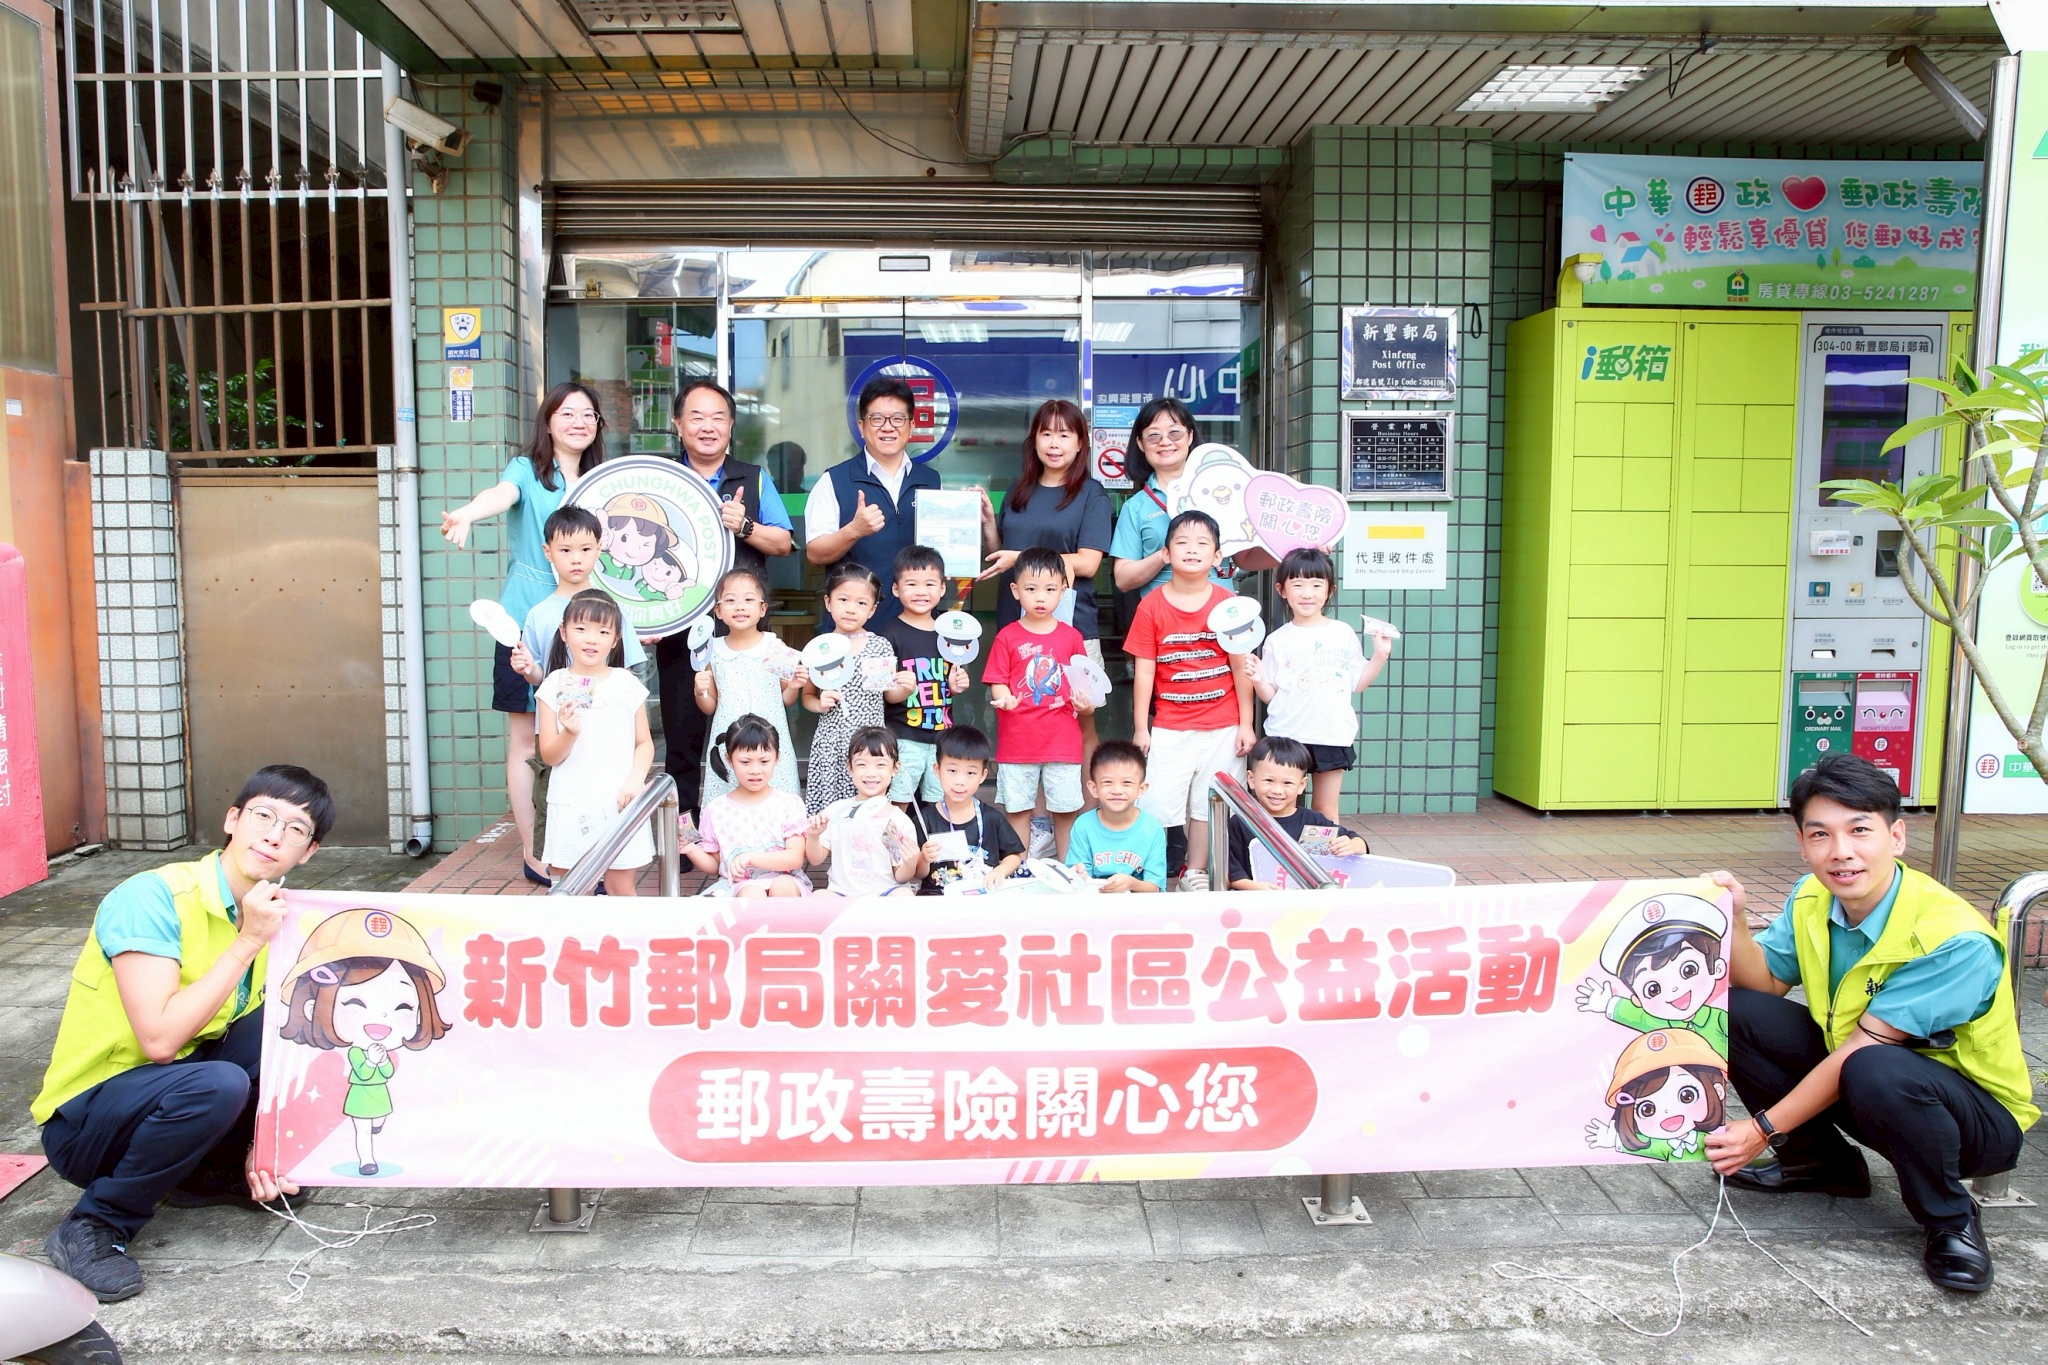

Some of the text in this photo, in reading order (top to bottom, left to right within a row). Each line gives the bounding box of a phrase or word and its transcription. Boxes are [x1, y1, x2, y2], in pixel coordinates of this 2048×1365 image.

[1683, 217, 1981, 251] 輕鬆享優貸 悠郵好成
[1363, 323, 1437, 342] 新豐郵局
[1817, 341, 1929, 352] 304-00 新豐郵局i郵箱
[1382, 350, 1417, 360] Xinfeng
[1581, 344, 1671, 381] i郵箱
[1372, 361, 1426, 369] Post Office
[1387, 378, 1398, 387] Zip
[1259, 491, 1332, 525] 郵政壽險
[599, 475, 716, 562] CHUNGHWA POST
[1259, 511, 1320, 541] 關心您
[1356, 552, 1434, 564] 代理收件處
[1401, 568, 1414, 576] Ship
[2005, 634, 2048, 642] 登錄網頁取號
[2009, 761, 2039, 774] 中華
[464, 924, 1560, 1030] 新竹郵局關愛社區公益活動
[697, 1062, 1258, 1146] 郵政壽險關心您
